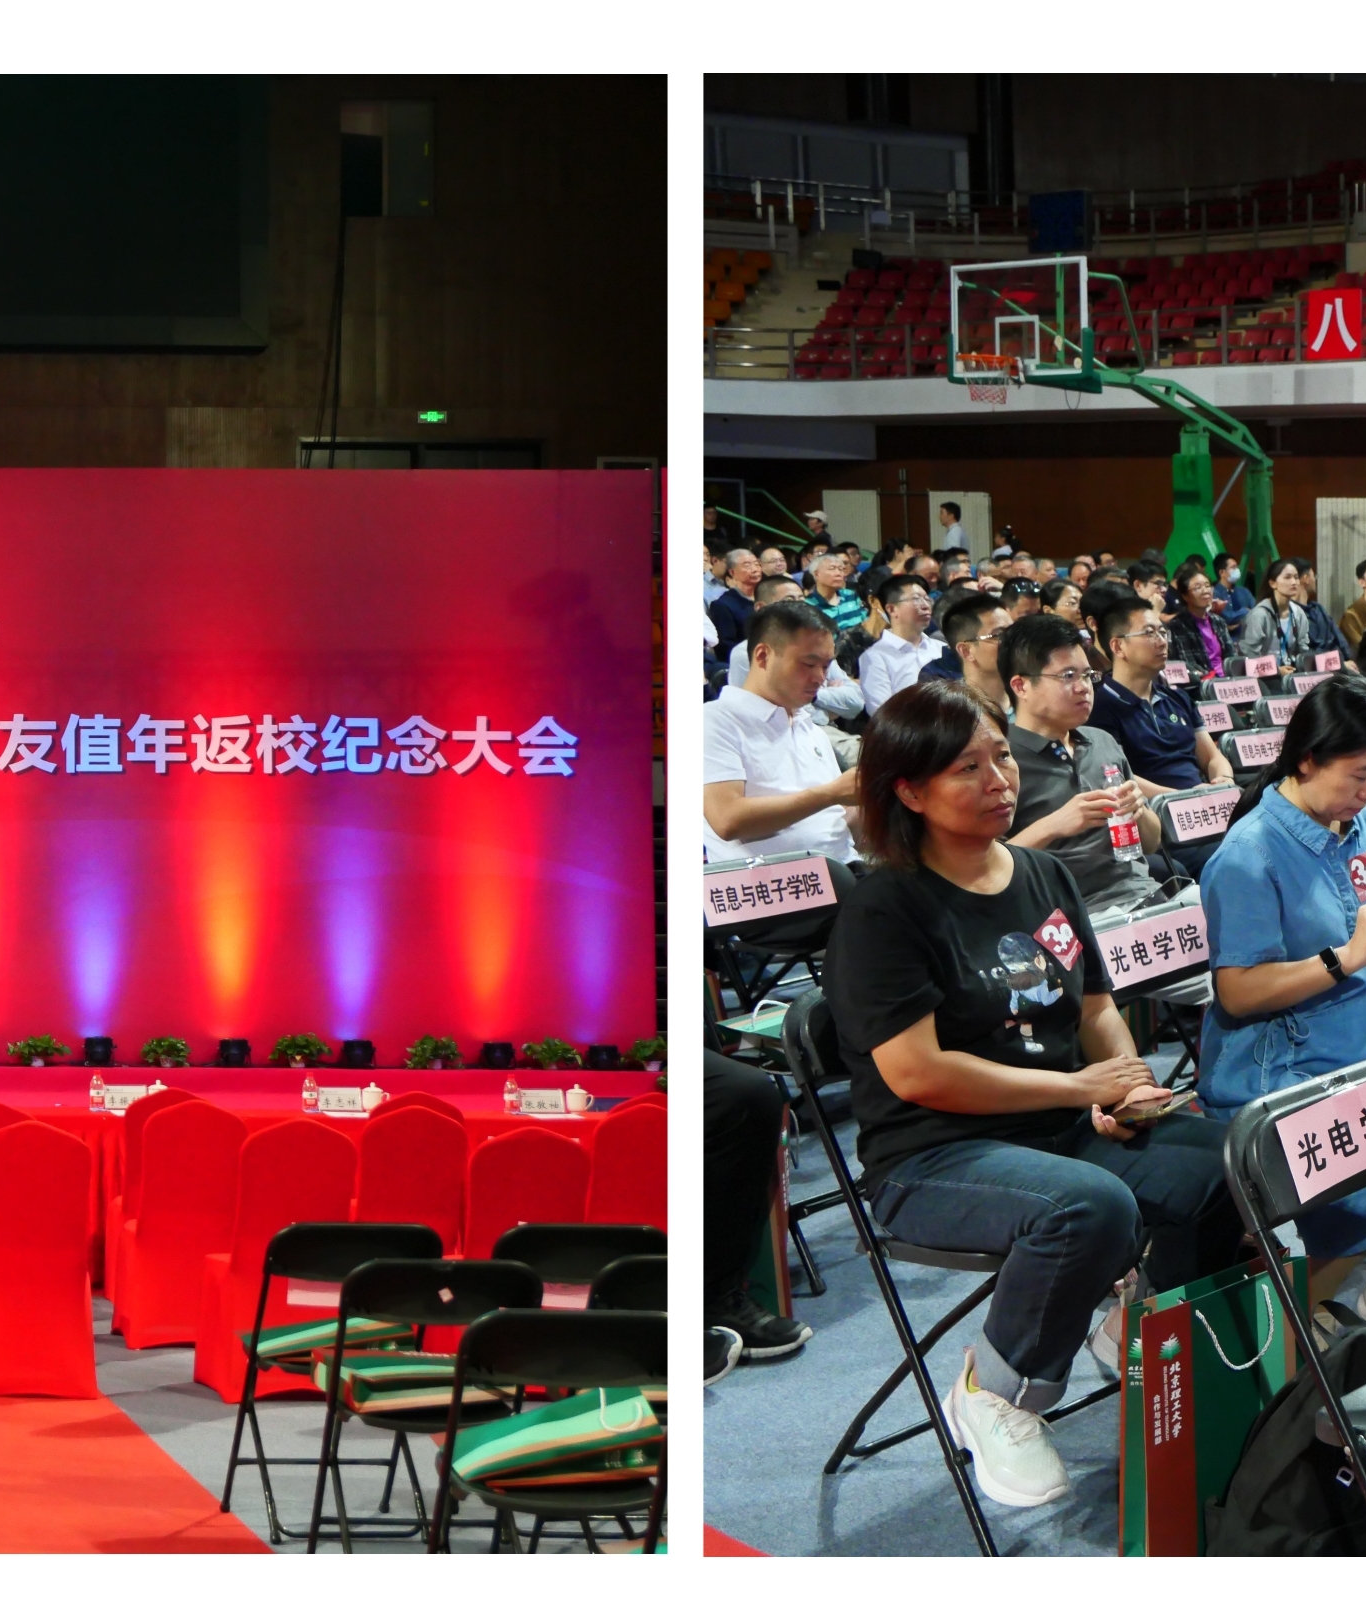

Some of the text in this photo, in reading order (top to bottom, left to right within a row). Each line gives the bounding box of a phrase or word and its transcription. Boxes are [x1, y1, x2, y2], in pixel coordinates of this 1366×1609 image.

[1217, 684, 1258, 700] 信息与电子学院
[710, 871, 824, 915] 信息与电子学院
[1109, 923, 1204, 976] 光电学院
